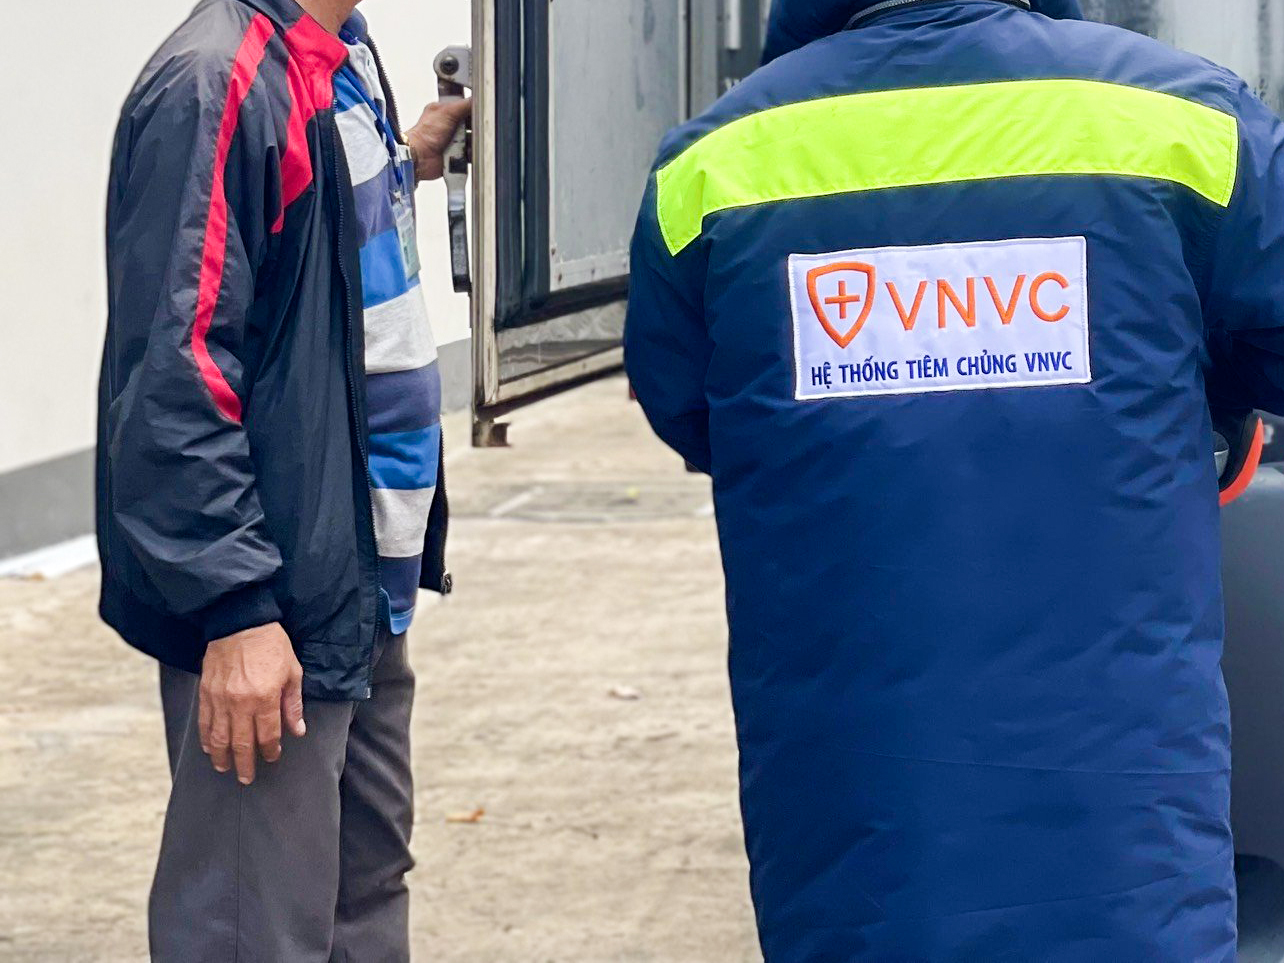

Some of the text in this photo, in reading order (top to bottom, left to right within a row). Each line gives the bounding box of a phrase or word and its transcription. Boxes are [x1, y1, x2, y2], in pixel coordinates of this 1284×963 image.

[885, 271, 1070, 331] VNVC
[811, 349, 1073, 389] HỆ THỐNG TIÊM CHỦNG VNVC
